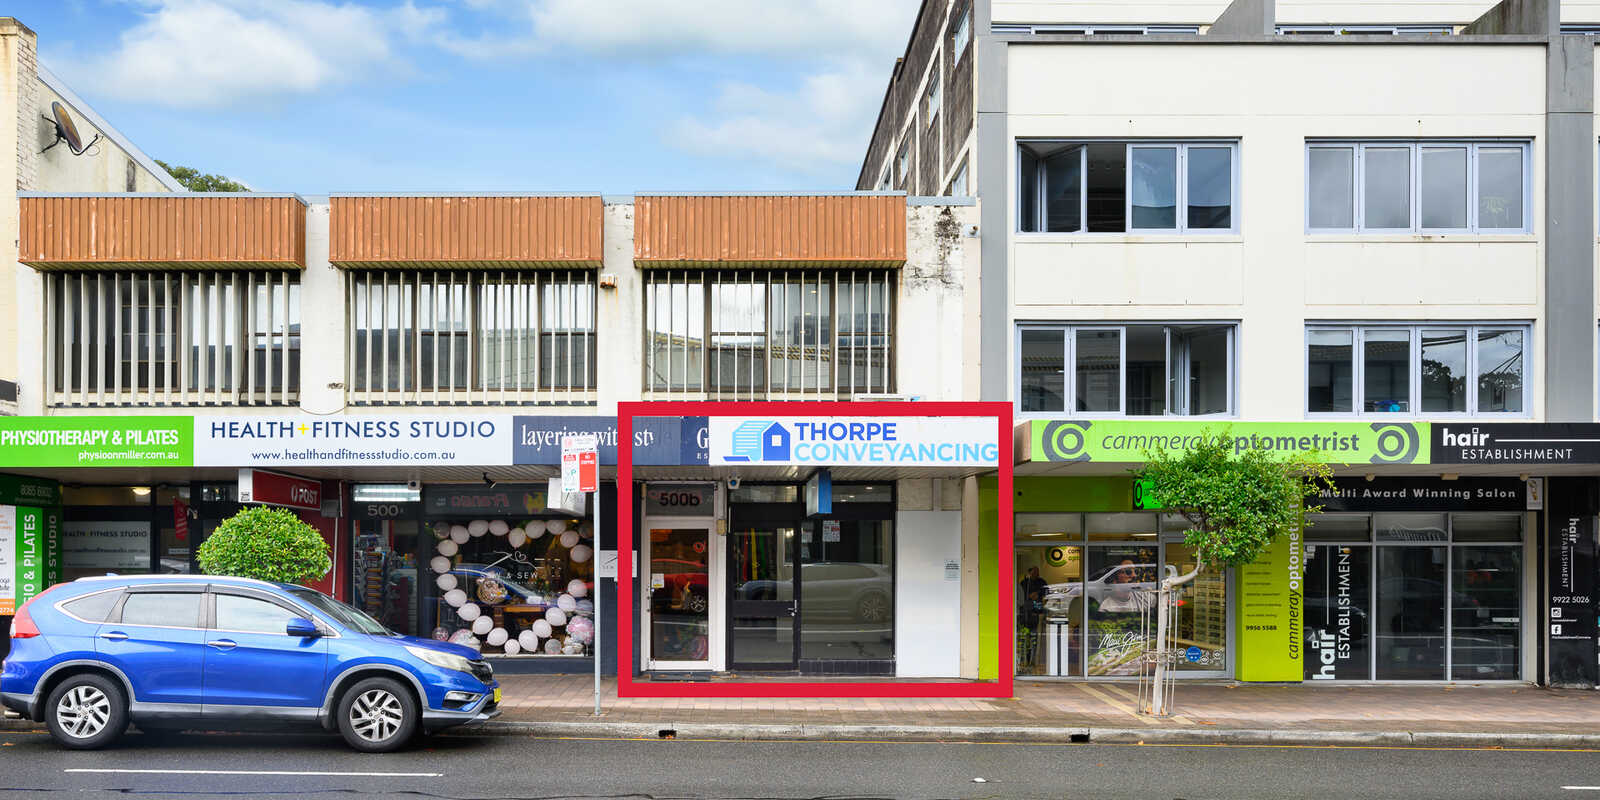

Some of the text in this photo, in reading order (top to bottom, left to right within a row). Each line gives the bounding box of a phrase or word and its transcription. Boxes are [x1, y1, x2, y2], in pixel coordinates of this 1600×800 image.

[1, 429, 179, 446] PHYSIOTHERAPY & PILATES
[410, 421, 496, 438] STUDIO
[794, 422, 897, 441] THORPE
[1443, 428, 1489, 447] hair
[78, 450, 179, 461] physioonmiller.com.au
[252, 449, 455, 460] www.healthandfitnessstudio.com.au
[794, 443, 998, 462] CONVEYANCING
[1462, 449, 1573, 460] ESTABLISHMENT
[299, 488, 318, 504] POST
[660, 492, 700, 506] 500b
[1321, 488, 1516, 500] Multi Award Winning Salon
[1569, 518, 1580, 543] hair
[24, 514, 35, 567] PILATES
[1561, 528, 1569, 588] ESTABLISHMENT
[1338, 545, 1350, 659] ESTABLISHMENT
[1312, 629, 1335, 680] hair
